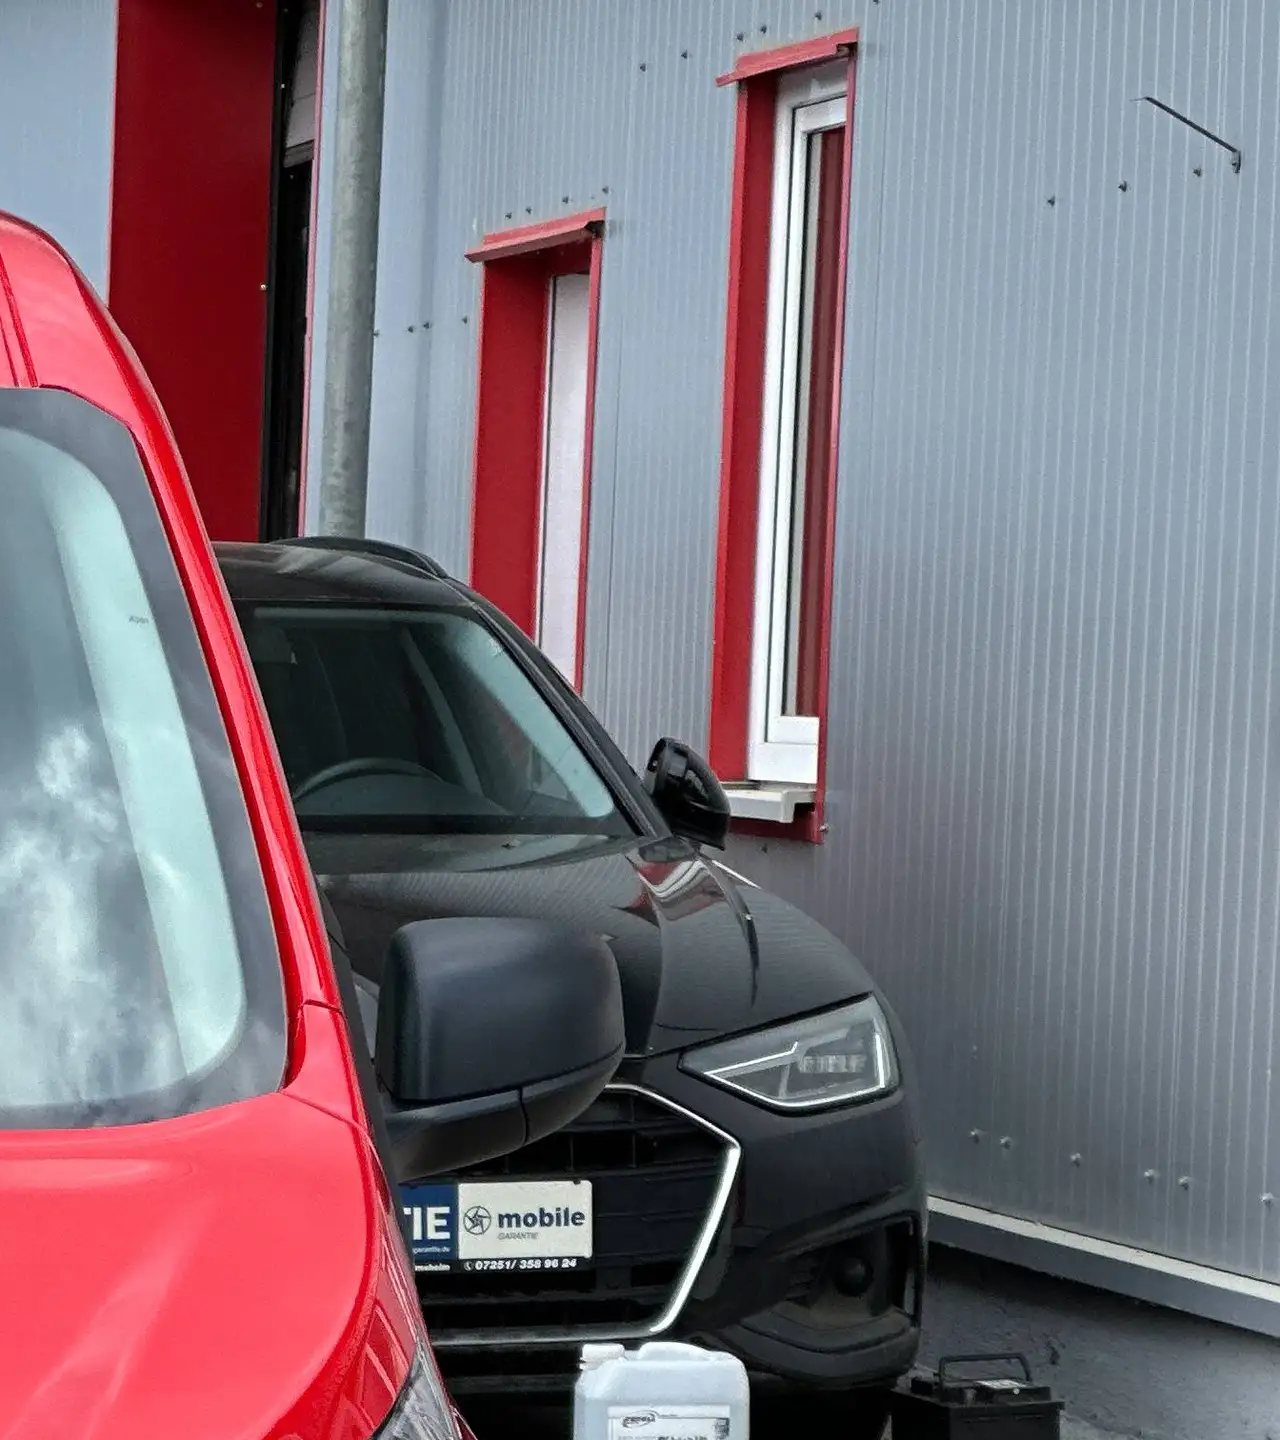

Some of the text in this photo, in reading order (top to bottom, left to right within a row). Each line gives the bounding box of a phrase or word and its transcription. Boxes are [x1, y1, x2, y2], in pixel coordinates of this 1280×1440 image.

[497, 1207, 586, 1228] mobile
[497, 1231, 539, 1240] GARANTIE
[474, 1260, 517, 1271] 07251/
[519, 1260, 541, 1270] 358
[544, 1259, 559, 1269] 96
[561, 1259, 578, 1269] 24
